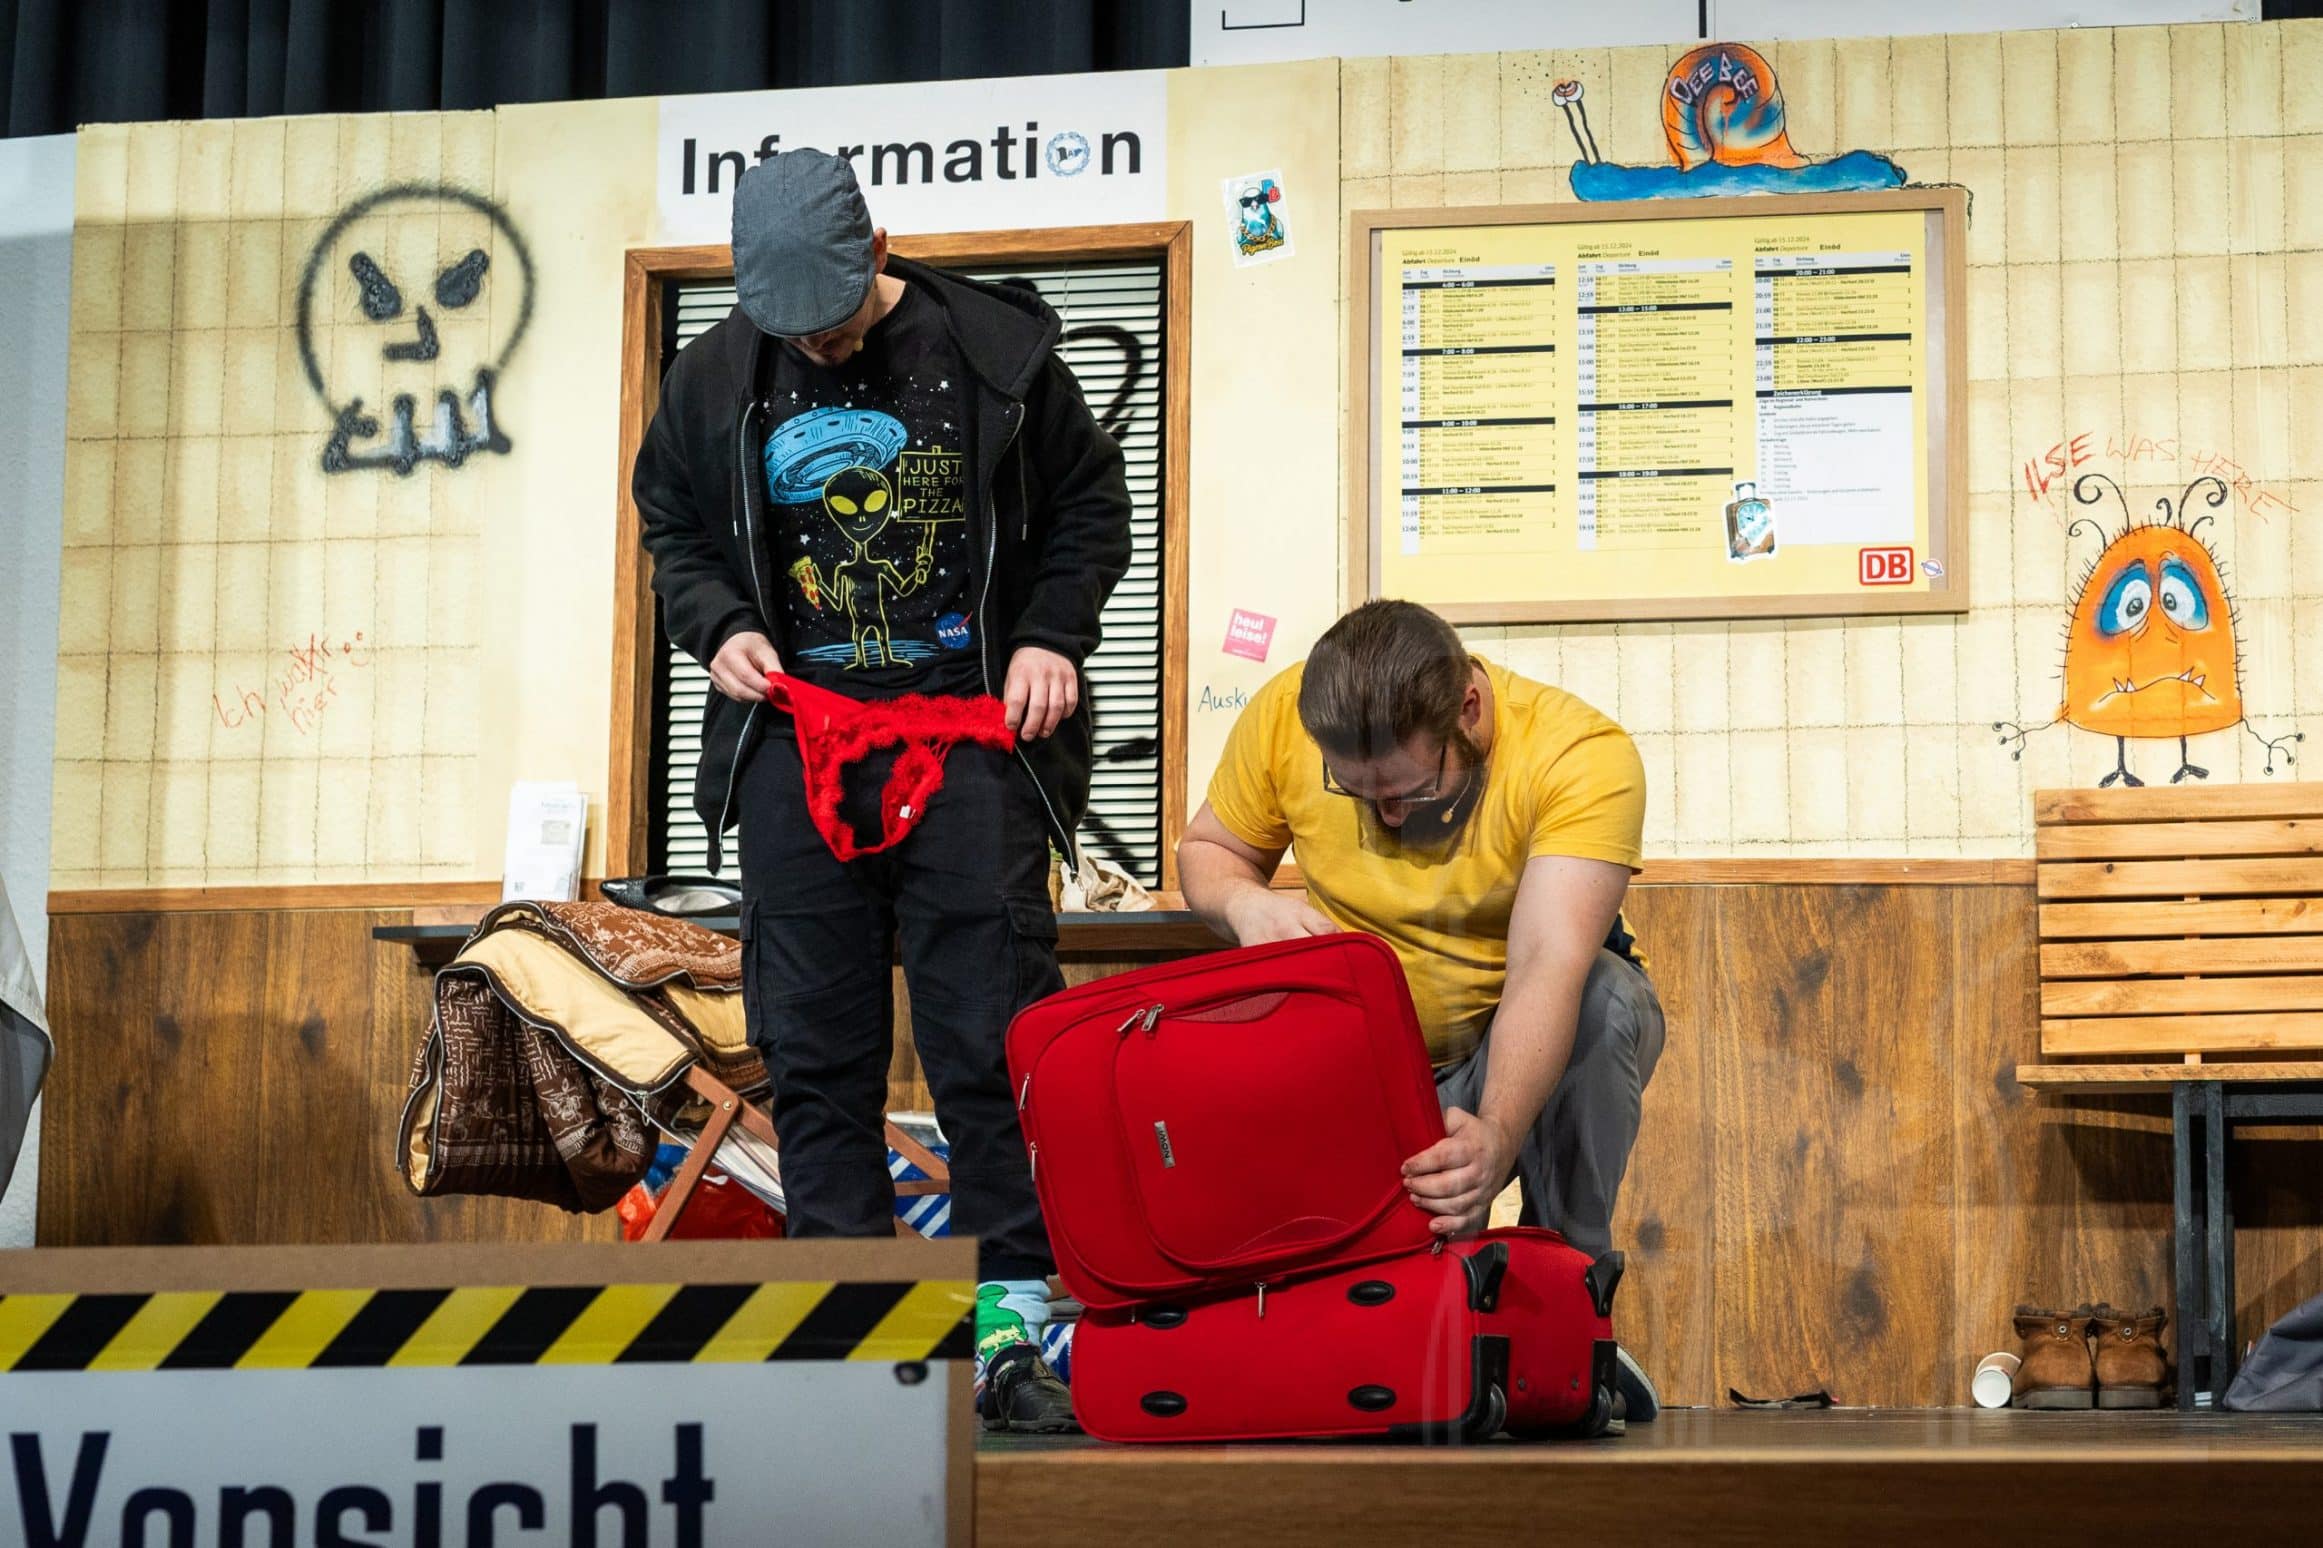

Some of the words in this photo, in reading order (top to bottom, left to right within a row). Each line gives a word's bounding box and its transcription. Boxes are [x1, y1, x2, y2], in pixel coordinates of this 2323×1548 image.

[682, 121, 1142, 196] Infrmatin
[2106, 432, 2177, 462] WAS
[909, 459, 963, 476] JUST
[903, 476, 939, 487] HERE
[919, 487, 944, 498] THE
[1865, 553, 1908, 580] DB
[937, 624, 969, 639] NASA
